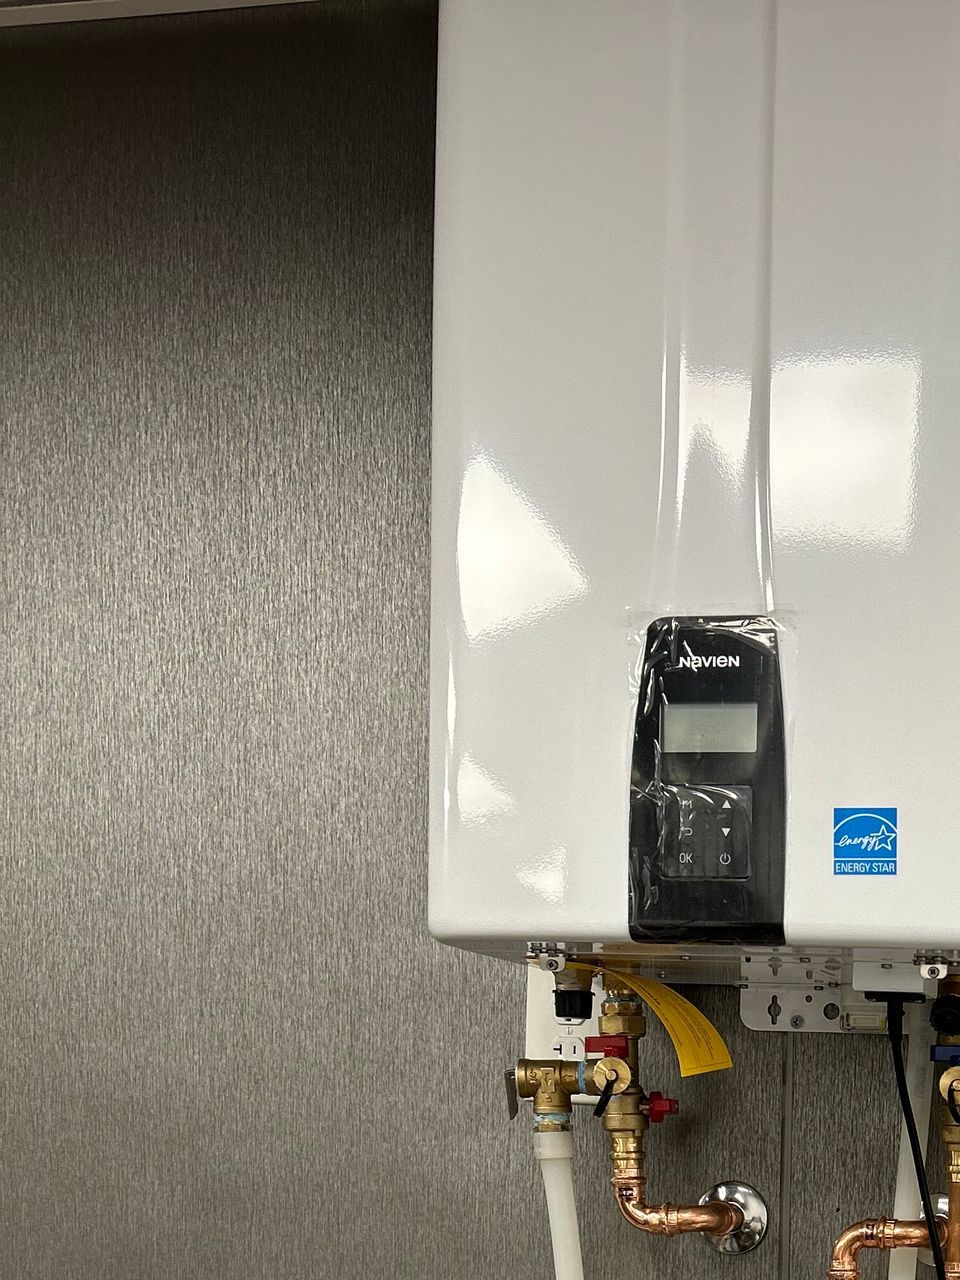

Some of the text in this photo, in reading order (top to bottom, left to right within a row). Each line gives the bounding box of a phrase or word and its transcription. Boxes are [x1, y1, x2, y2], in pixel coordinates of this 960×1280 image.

[679, 853, 693, 864] OK
[835, 862, 895, 873] ENERGY STAR
